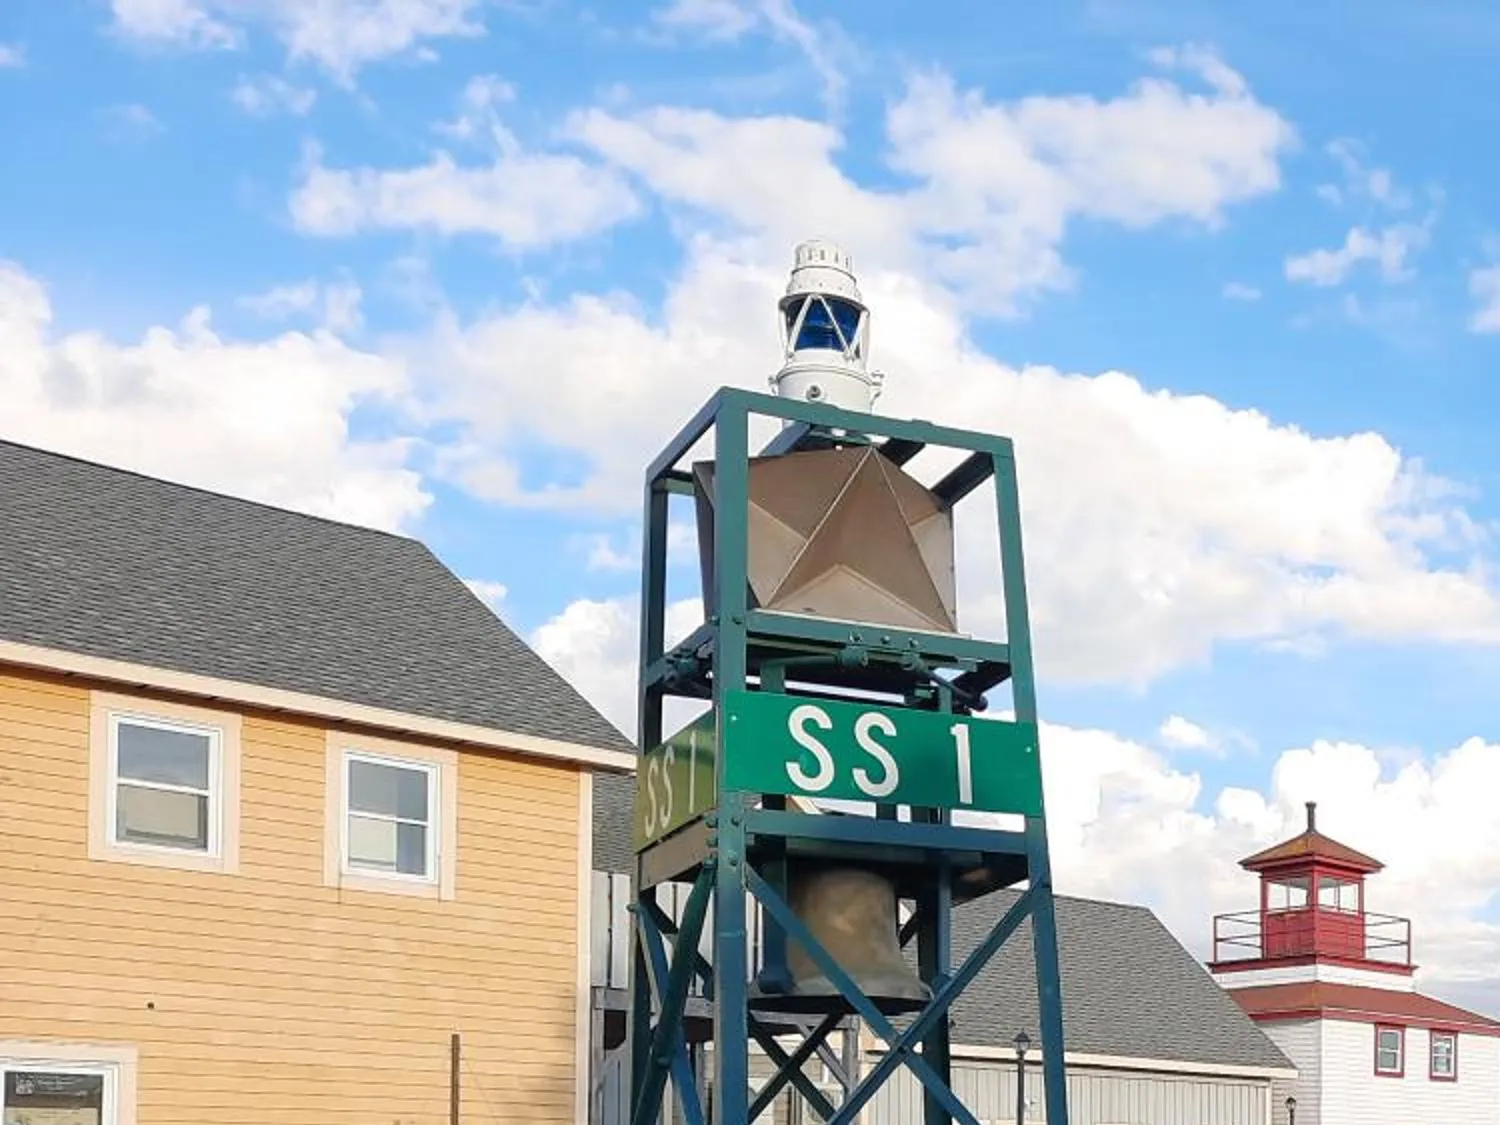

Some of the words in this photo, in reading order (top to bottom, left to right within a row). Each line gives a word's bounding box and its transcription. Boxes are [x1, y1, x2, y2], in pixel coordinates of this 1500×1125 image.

[644, 744, 675, 839] SS
[689, 731, 697, 814] 1
[785, 704, 899, 797] SS
[950, 723, 972, 804] 1
